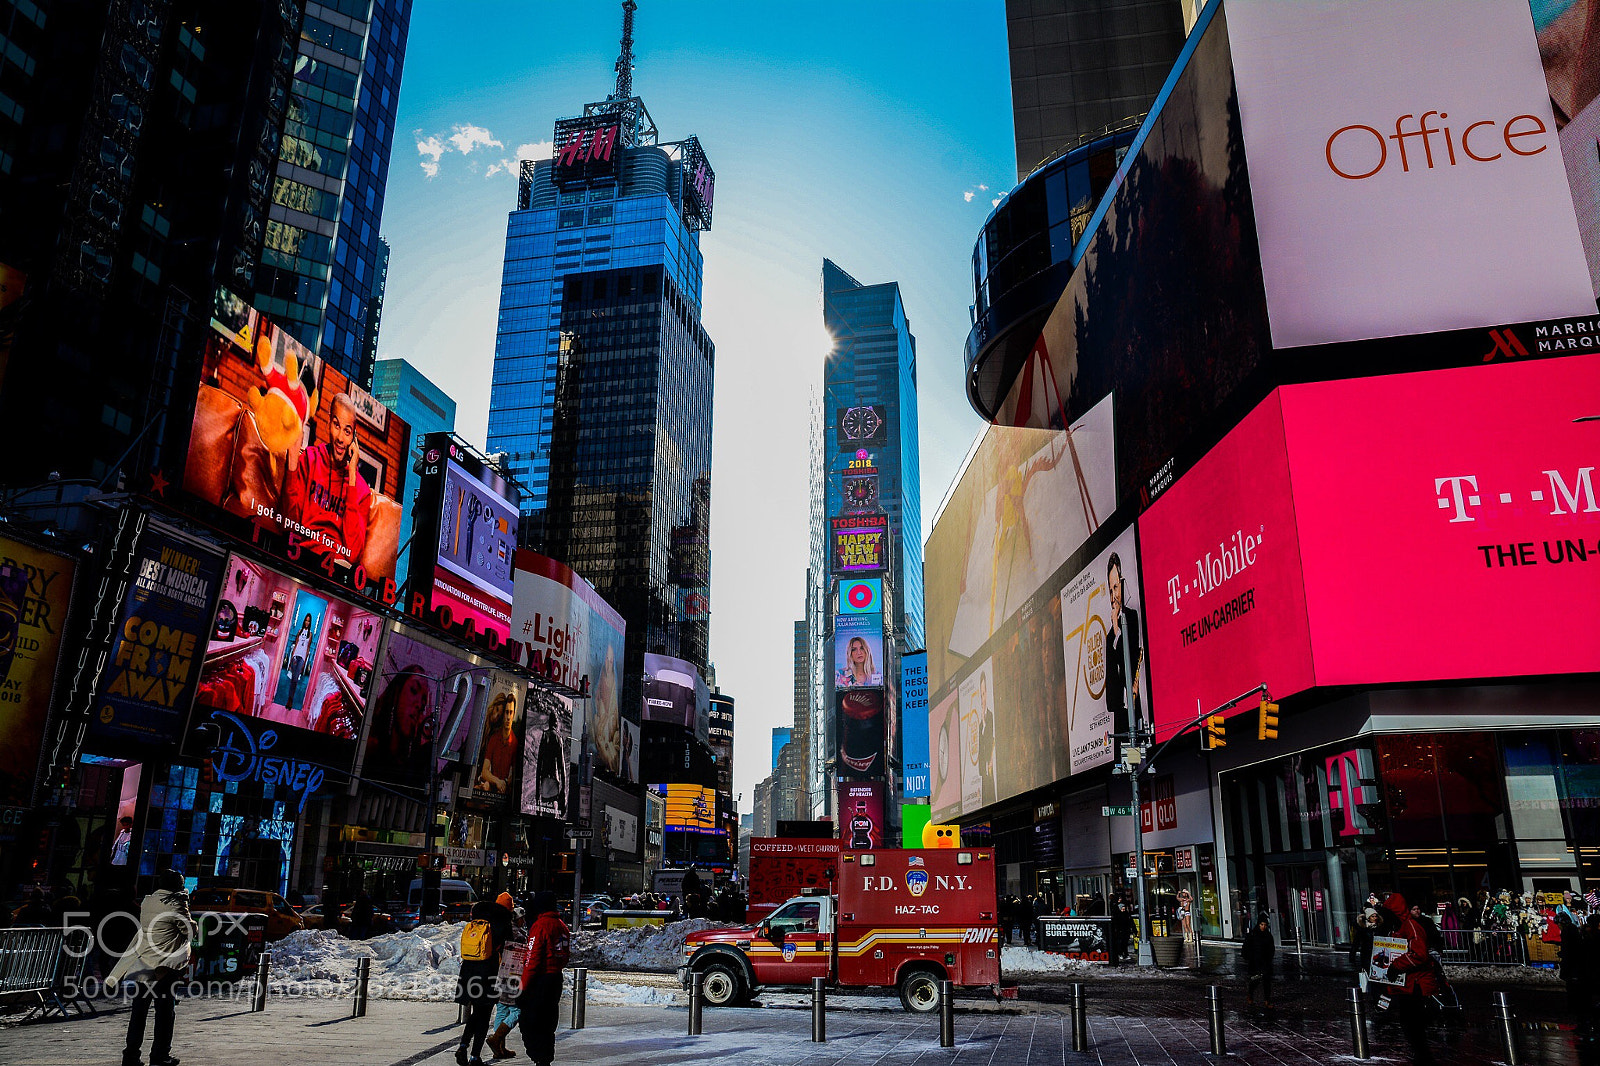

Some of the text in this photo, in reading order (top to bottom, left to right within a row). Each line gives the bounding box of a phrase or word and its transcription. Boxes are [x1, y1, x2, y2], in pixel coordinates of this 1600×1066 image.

[556, 124, 618, 166] H&M
[1326, 110, 1547, 180] Office
[456, 450, 464, 462] LG
[848, 460, 872, 469] 2018
[425, 466, 438, 475] LG
[842, 467, 878, 476] TOSHIBA
[1149, 457, 1175, 488] MARRIOTT
[1150, 472, 1174, 499] MARQUIS
[250, 498, 352, 558] I got a present for you
[832, 516, 887, 529] TOSHIBA
[838, 532, 882, 546] HAPPY
[844, 543, 875, 555] NEW
[160, 546, 201, 576] WINNER!
[841, 554, 878, 566] YEAR!
[1478, 540, 1600, 568] THE UN-
[139, 558, 209, 600] BEST MUSICAL
[135, 576, 147, 588] ALL
[167, 587, 184, 602] NORTH
[184, 592, 206, 608] AMERICA
[461, 593, 470, 603] FOR
[382, 577, 557, 678] BROADWAY
[1180, 589, 1254, 648] THE UN-CARRIER
[124, 616, 198, 659] COME
[522, 613, 576, 657] #Light
[1087, 630, 1102, 654] GOLDEN
[905, 667, 922, 676] THE
[1089, 664, 1104, 686] AWARDS
[106, 668, 185, 708] AWAY
[905, 699, 928, 710] KEEP
[1158, 803, 1174, 826] QLO
[373, 856, 414, 871] FOREVER 21
[452, 848, 466, 858] POLO
[863, 876, 972, 891] F.D. N.Y.
[895, 905, 939, 915] HAZ-TAC
[961, 928, 995, 944] FDNY
